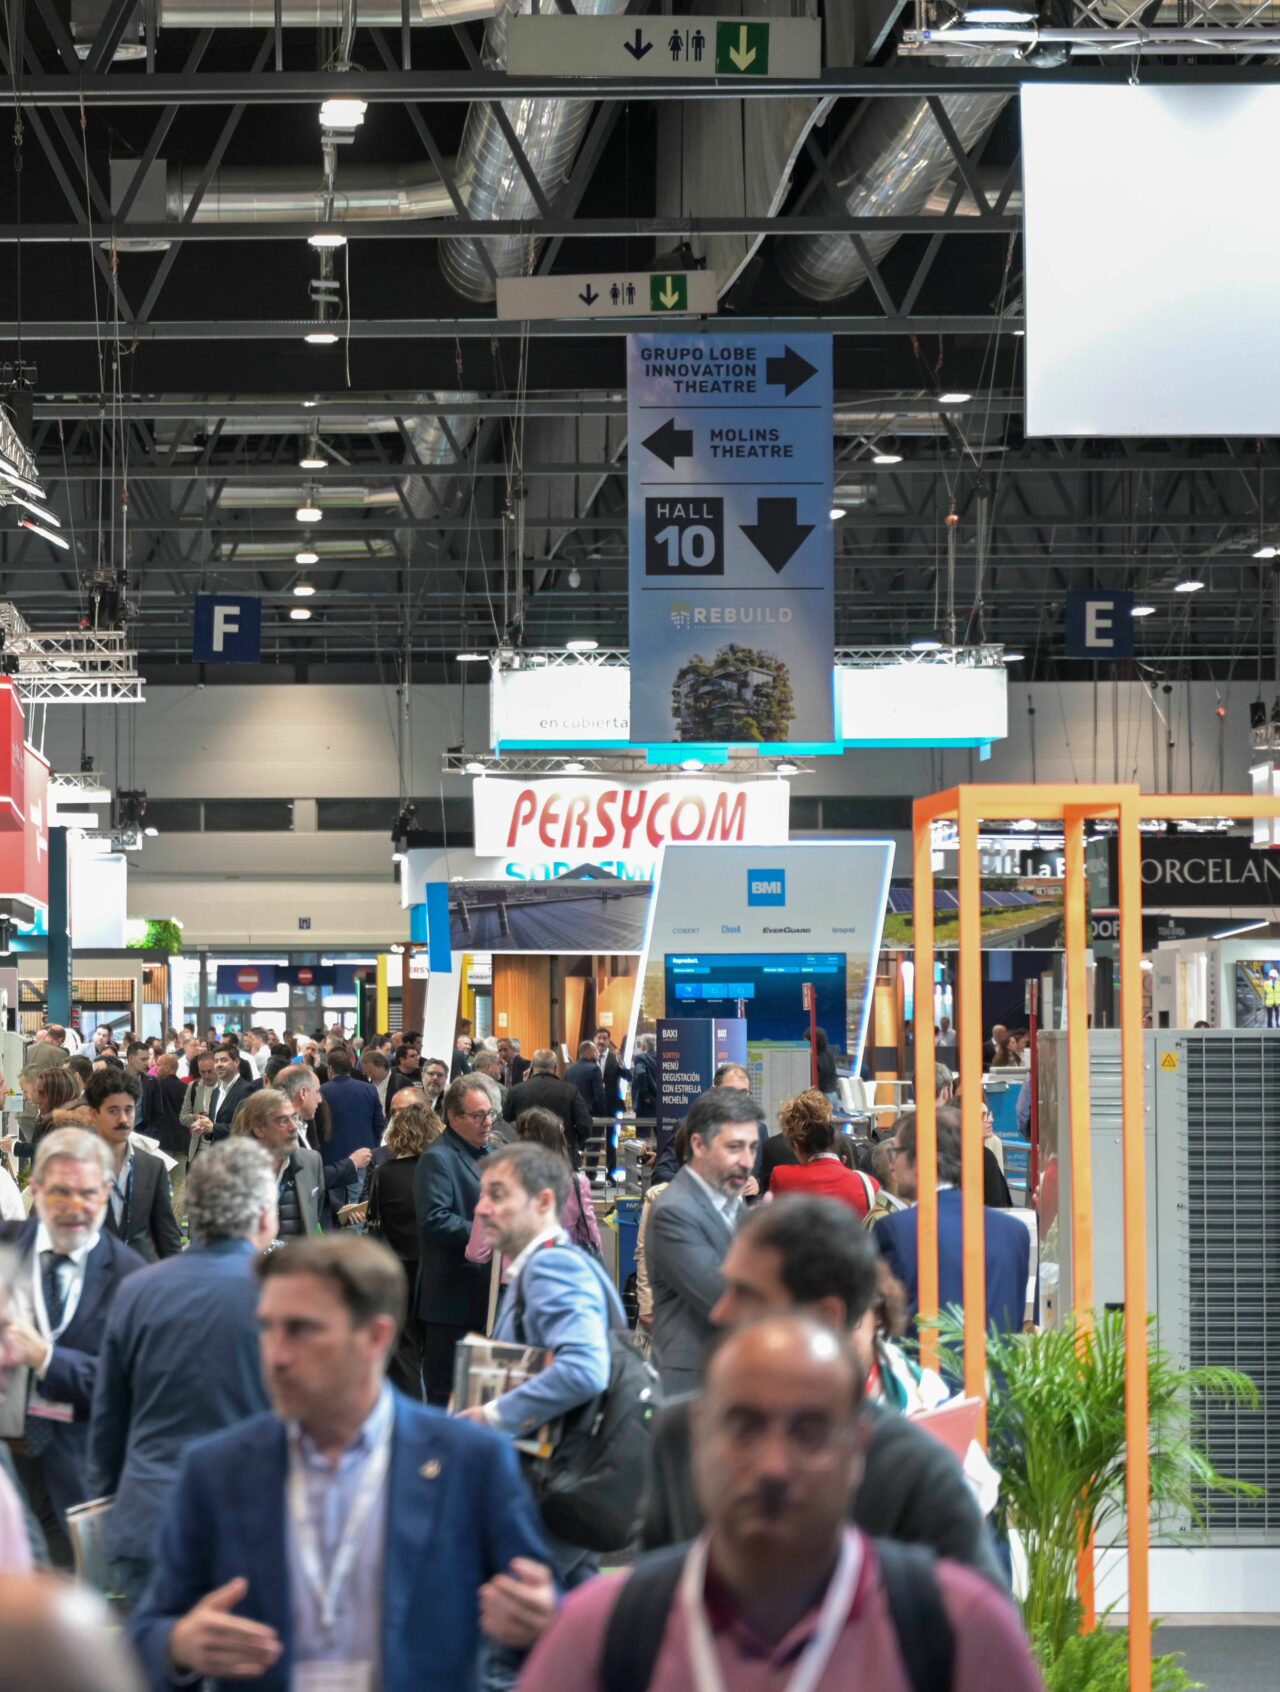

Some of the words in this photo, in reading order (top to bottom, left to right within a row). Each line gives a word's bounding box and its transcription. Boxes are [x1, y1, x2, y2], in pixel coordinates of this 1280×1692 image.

[641, 347, 703, 361] GRUPO
[709, 347, 756, 361] LOBE
[645, 364, 756, 377] INNOVATION
[673, 380, 757, 393] THEATRE
[710, 428, 780, 442] MOLINS
[710, 444, 794, 458] THEATRE
[656, 503, 714, 519] HALL
[654, 524, 716, 567] 10
[694, 607, 793, 624] REBUILD
[213, 605, 240, 652] F
[1085, 601, 1114, 648] E
[539, 718, 558, 729] en
[506, 789, 748, 849] PERSYCOM
[1141, 858, 1280, 885] ORCELAN
[751, 881, 782, 894] BMI
[662, 1029, 678, 1038] BAXI
[662, 1061, 679, 1070] MENÚ
[662, 1072, 700, 1082] DEGUSTACIÓN
[662, 1084, 674, 1093] CON
[675, 1084, 701, 1093] ESTRELLA
[662, 1095, 688, 1104] MICHELÍN
